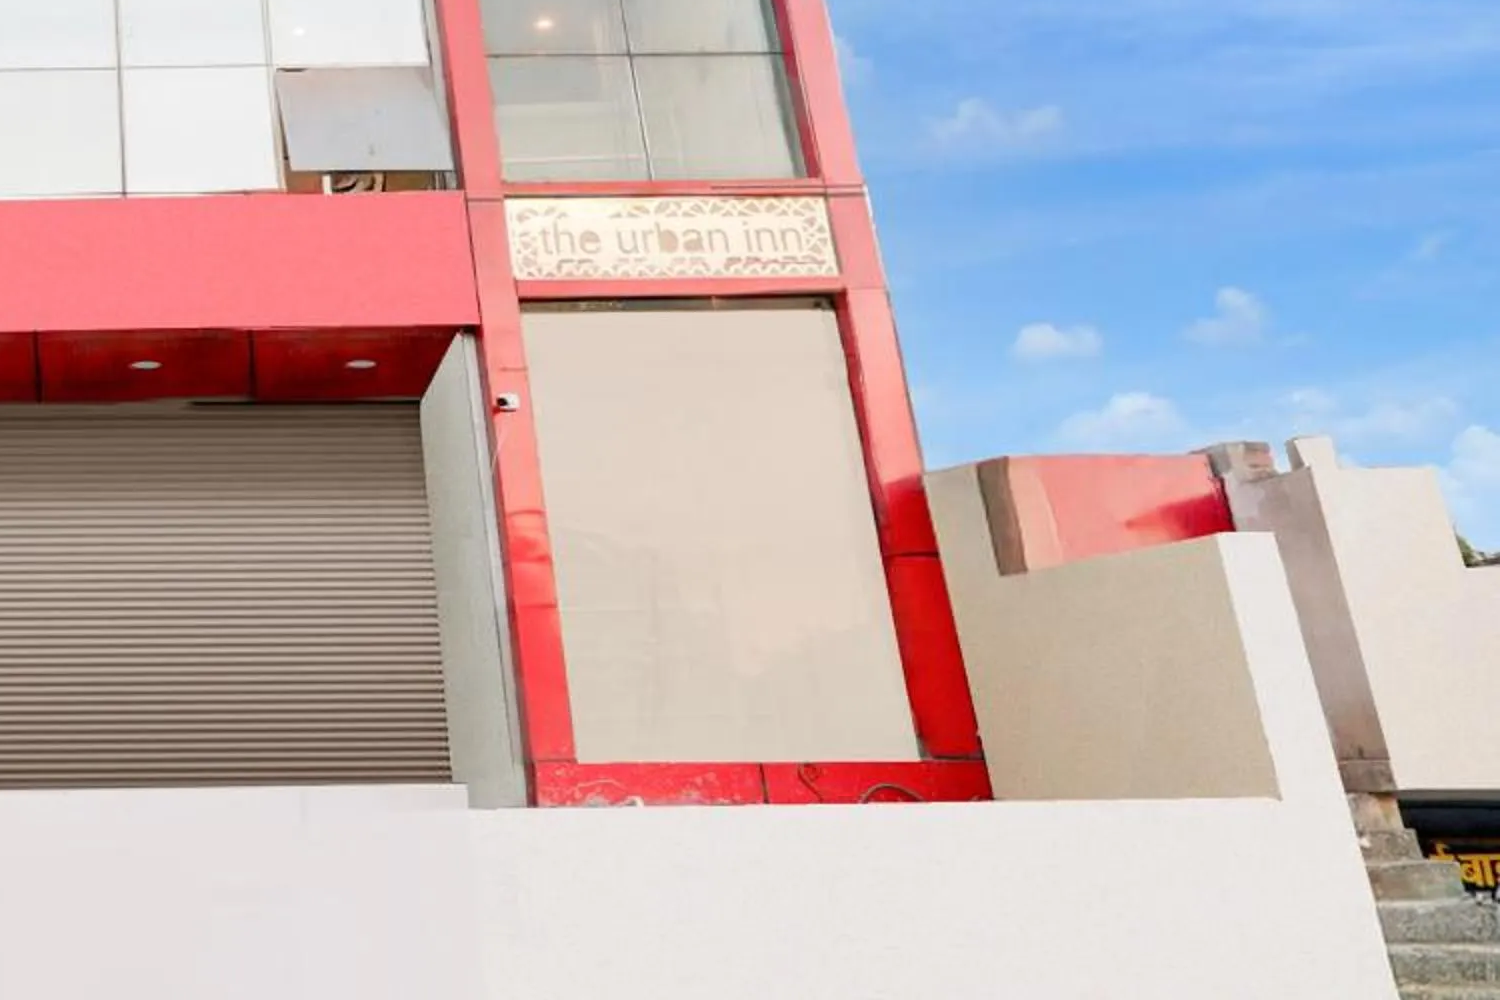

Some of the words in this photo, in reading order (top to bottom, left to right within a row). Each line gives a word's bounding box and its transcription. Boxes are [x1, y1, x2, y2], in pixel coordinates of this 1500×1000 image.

[539, 219, 602, 256] the
[615, 222, 731, 255] urban
[742, 220, 805, 254] inn
